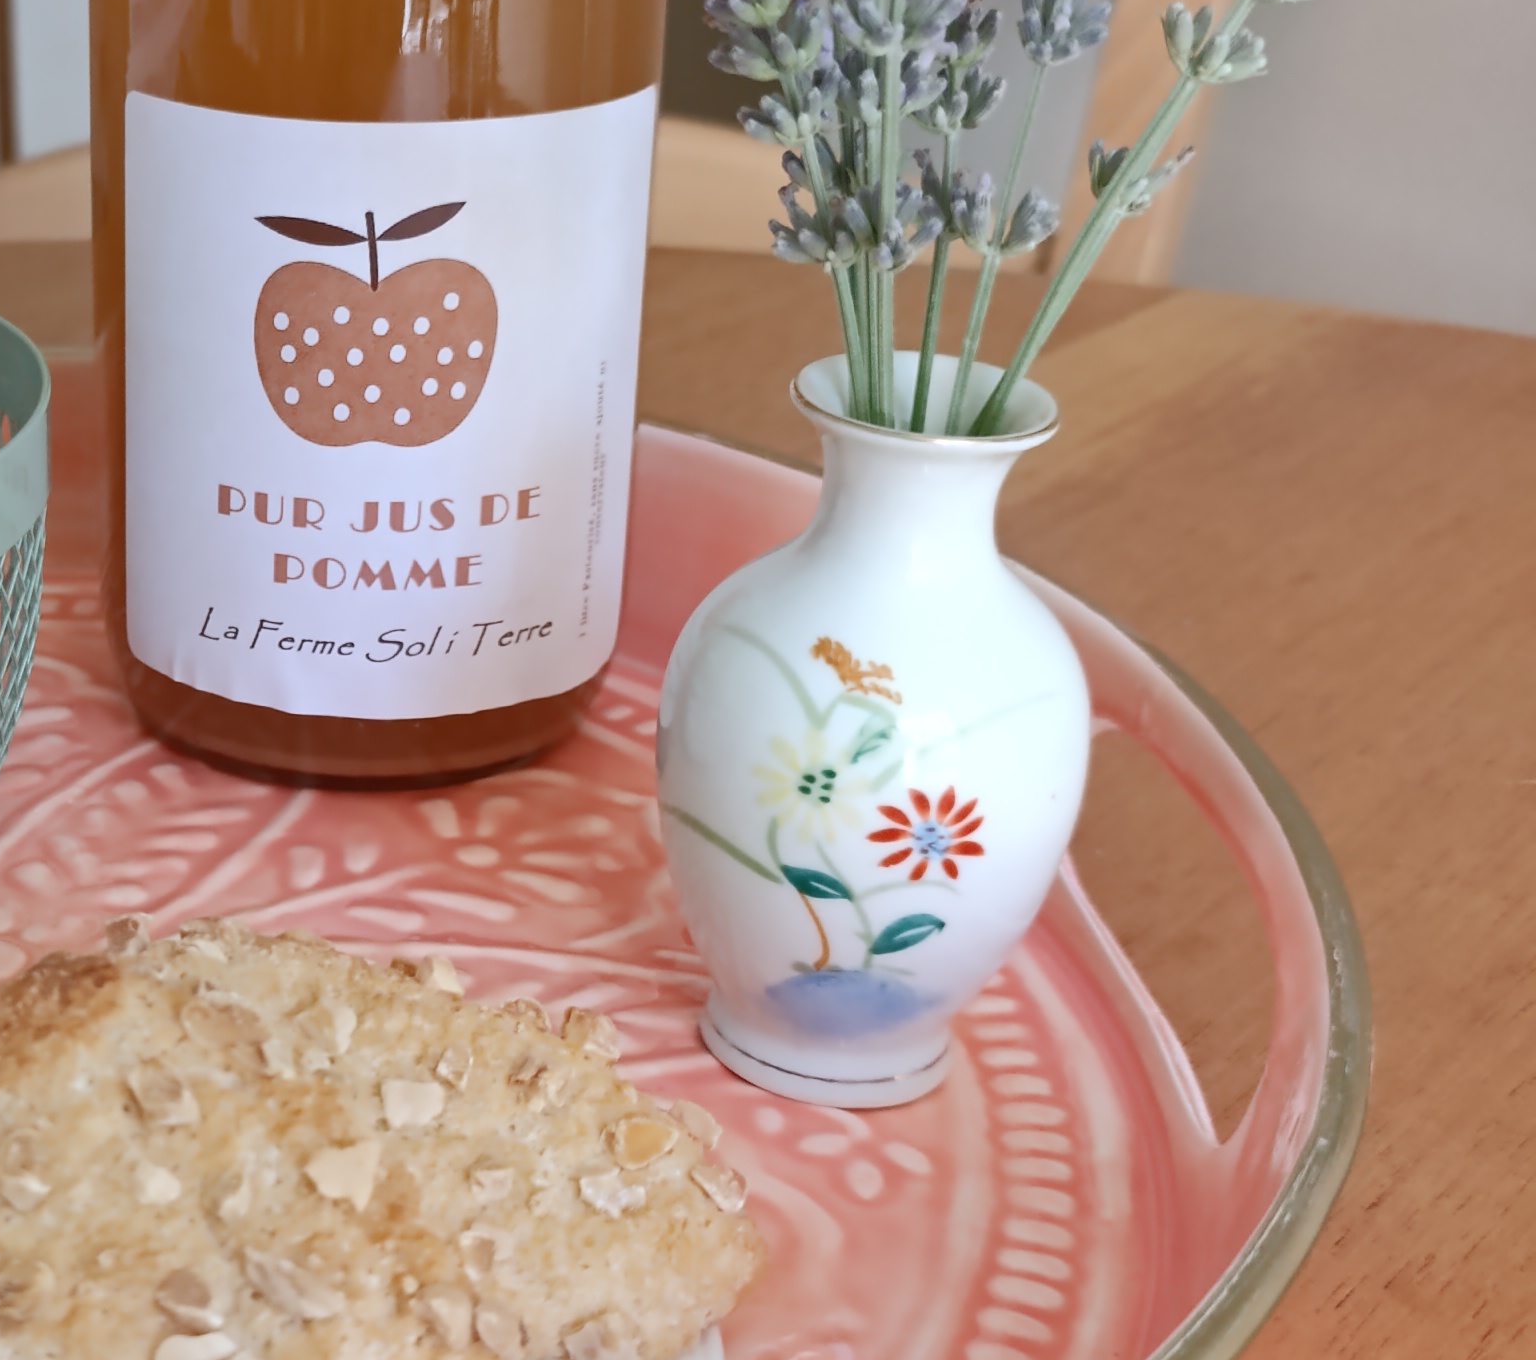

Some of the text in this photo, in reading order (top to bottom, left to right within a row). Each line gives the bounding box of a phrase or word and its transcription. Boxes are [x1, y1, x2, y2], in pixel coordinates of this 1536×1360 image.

[217, 483, 542, 534] PUR JUS DE
[272, 552, 484, 591] POMME
[198, 606, 240, 641] La
[248, 618, 356, 657] Ferme
[471, 619, 554, 657] Terre
